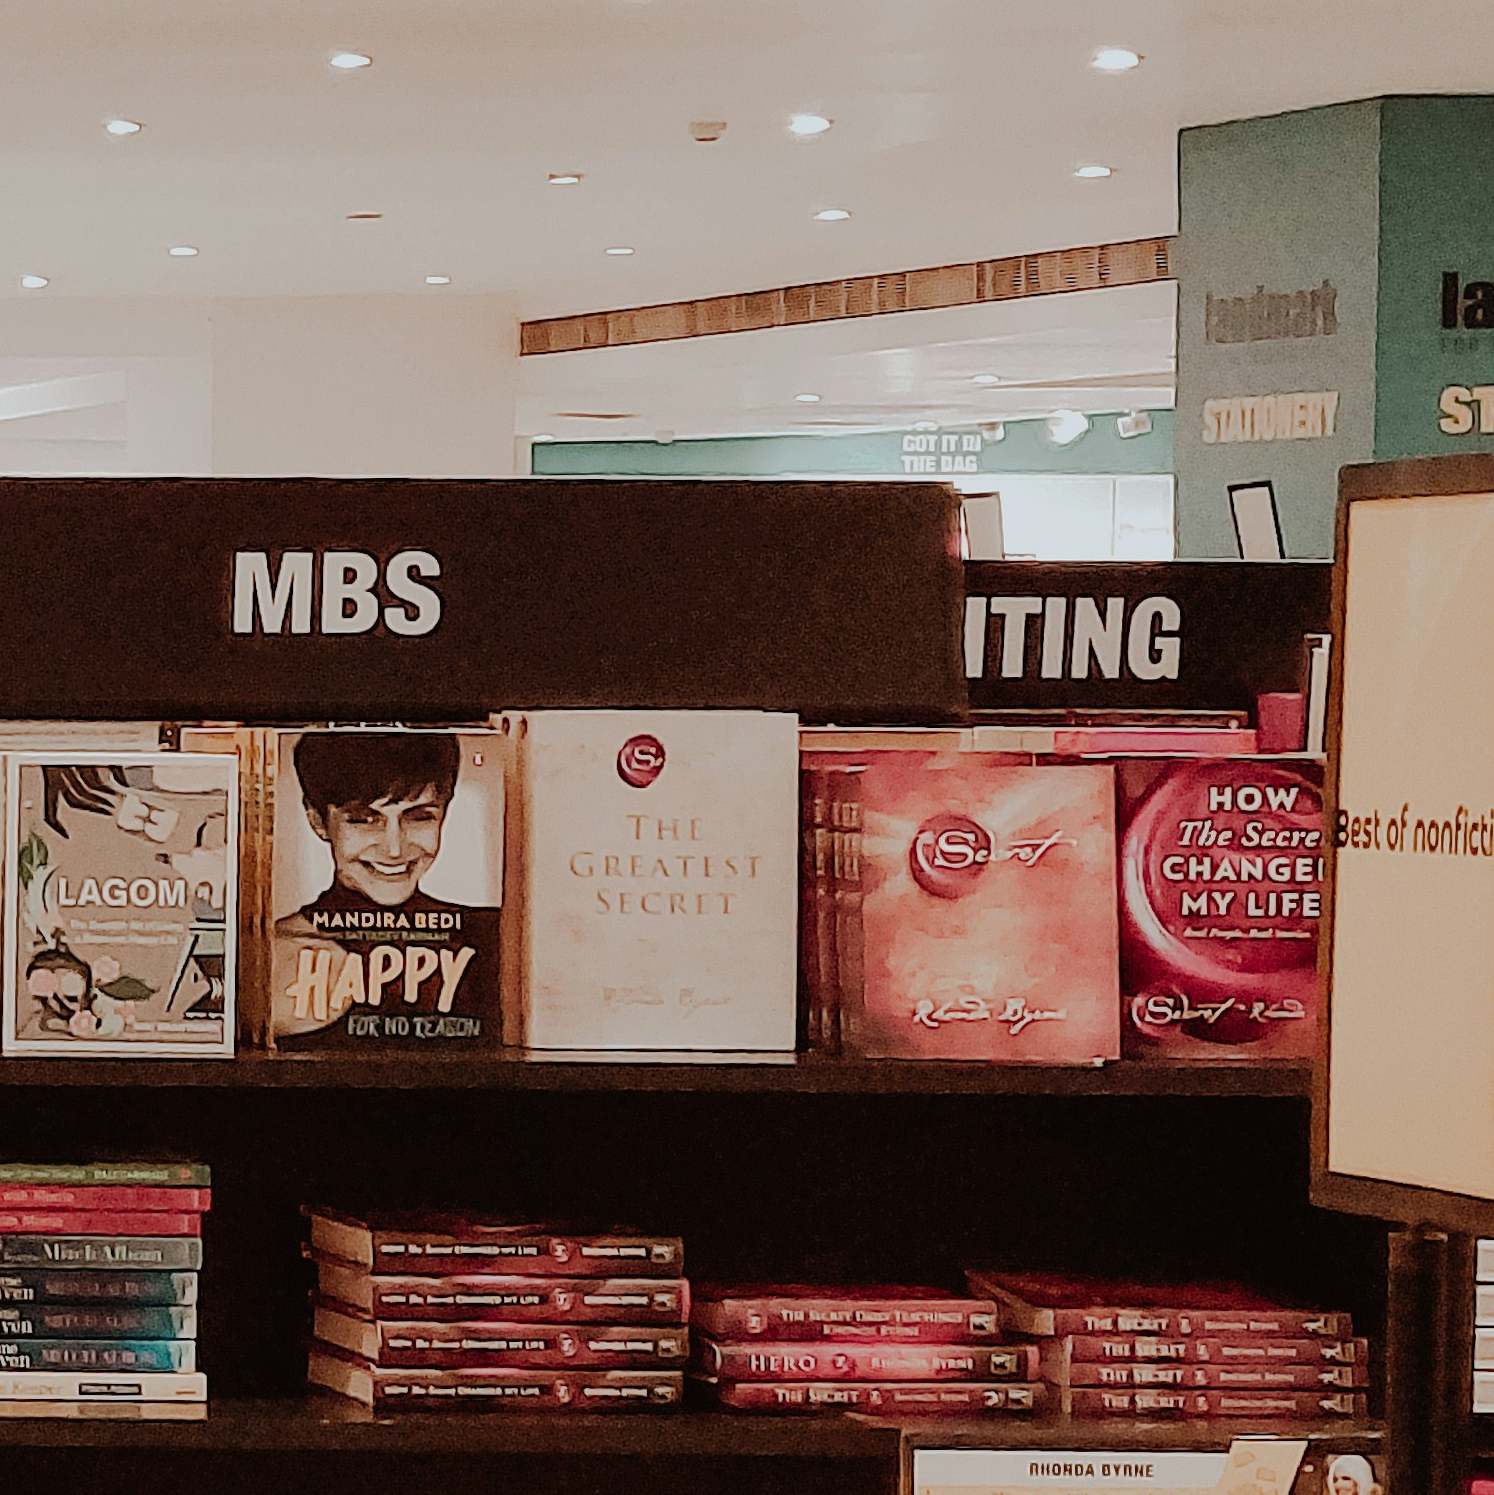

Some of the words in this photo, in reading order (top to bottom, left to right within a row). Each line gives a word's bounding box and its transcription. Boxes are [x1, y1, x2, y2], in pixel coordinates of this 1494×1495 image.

[232, 549, 442, 636] MBS
[963, 596, 1181, 680] ITING
[1210, 786, 1299, 811] HOW
[626, 813, 703, 841] THE
[1178, 819, 1236, 848] The
[1242, 820, 1321, 849] Secre
[1337, 809, 1380, 850] Best
[1387, 804, 1409, 851] of
[569, 850, 761, 879] GREATEST
[58, 878, 186, 908] LAGOM
[596, 888, 738, 915] SECRET
[1181, 891, 1235, 917] MY
[1248, 893, 1321, 918] LIFE
[313, 911, 409, 930] MANDIRA
[414, 912, 461, 931] BEDI
[285, 945, 476, 1020] HAPPY
[749, 1355, 816, 1373] HERO
[1029, 1462, 1096, 1478] RHONDA
[1101, 1463, 1154, 1478] BYRNE
